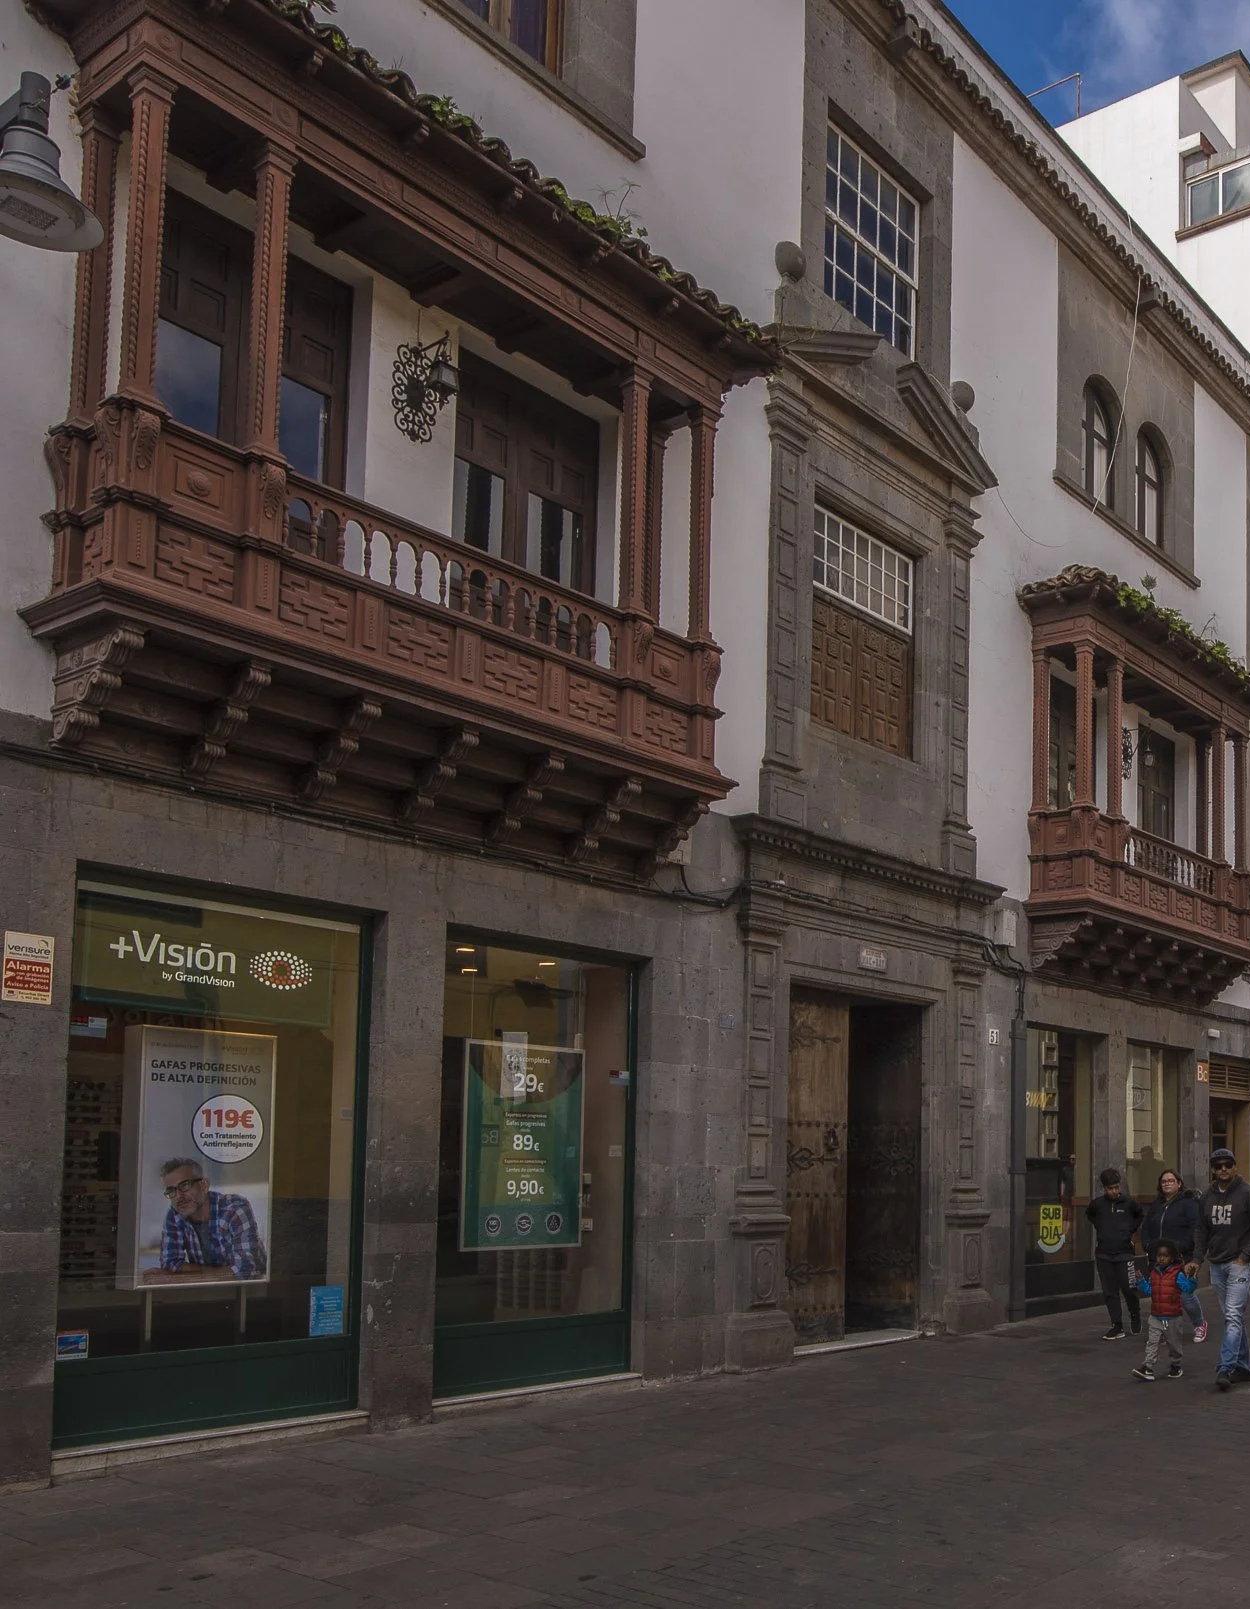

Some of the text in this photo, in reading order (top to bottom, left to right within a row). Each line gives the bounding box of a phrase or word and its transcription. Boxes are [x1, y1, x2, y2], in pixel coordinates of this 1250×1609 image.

[8, 944, 50, 955] verisure
[7, 961, 50, 973] Alarma
[162, 971, 235, 988] by GrandVision
[990, 1031, 998, 1044] 51
[151, 1060, 261, 1074] GAFAS PROGRESIVAS
[1197, 1065, 1208, 1082] Bc
[151, 1072, 256, 1086] DE ALTA DEFINICIÓN
[514, 1074, 544, 1092] 29€
[202, 1108, 254, 1128] 119€
[203, 1141, 253, 1149] Antirreflejante
[513, 1134, 540, 1151] 89€
[507, 1180, 544, 1198] 9,90€
[1042, 1207, 1061, 1220] SUB
